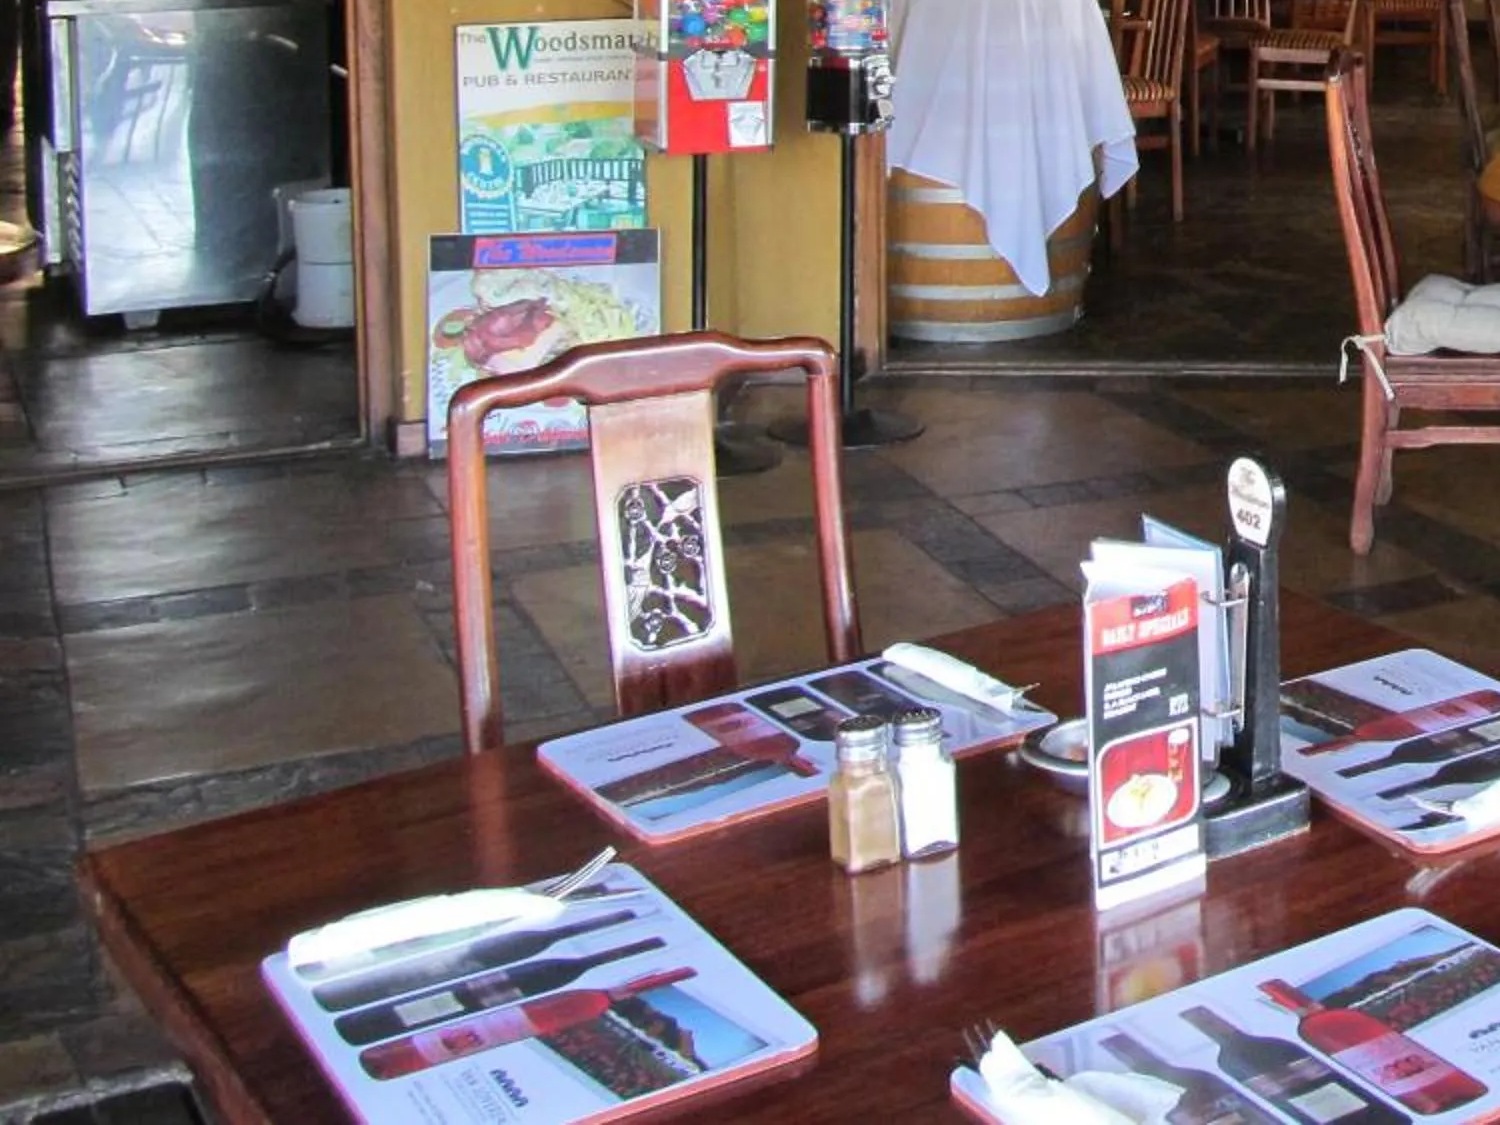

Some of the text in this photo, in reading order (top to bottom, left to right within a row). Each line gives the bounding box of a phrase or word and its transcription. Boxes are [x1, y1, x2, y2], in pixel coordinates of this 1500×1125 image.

[463, 69, 632, 87] PUB & RESTAURAN
[1236, 507, 1261, 530] 402
